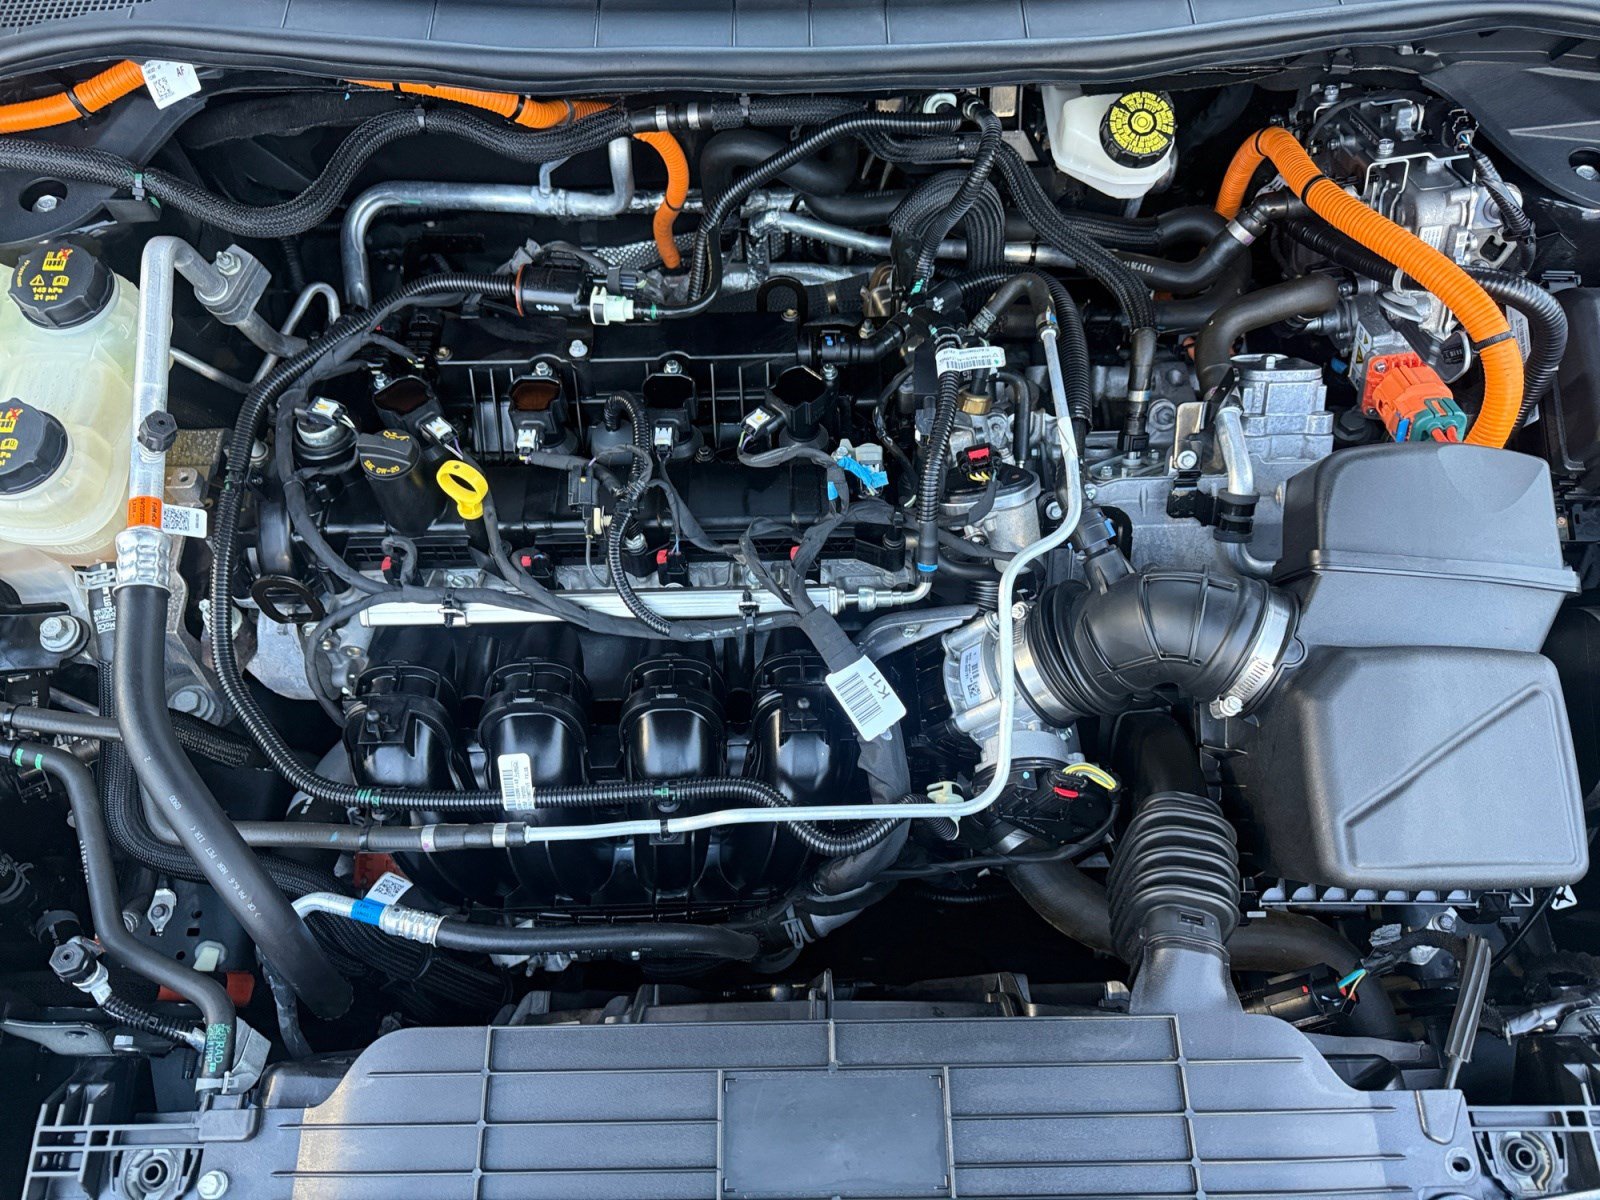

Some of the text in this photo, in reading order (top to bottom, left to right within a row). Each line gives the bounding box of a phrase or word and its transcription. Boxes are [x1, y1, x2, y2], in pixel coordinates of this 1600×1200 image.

[45, 294, 58, 302] psi
[364, 460, 400, 475] SAE 0W-20
[868, 671, 891, 700] K11
[214, 1041, 225, 1063] RAD
